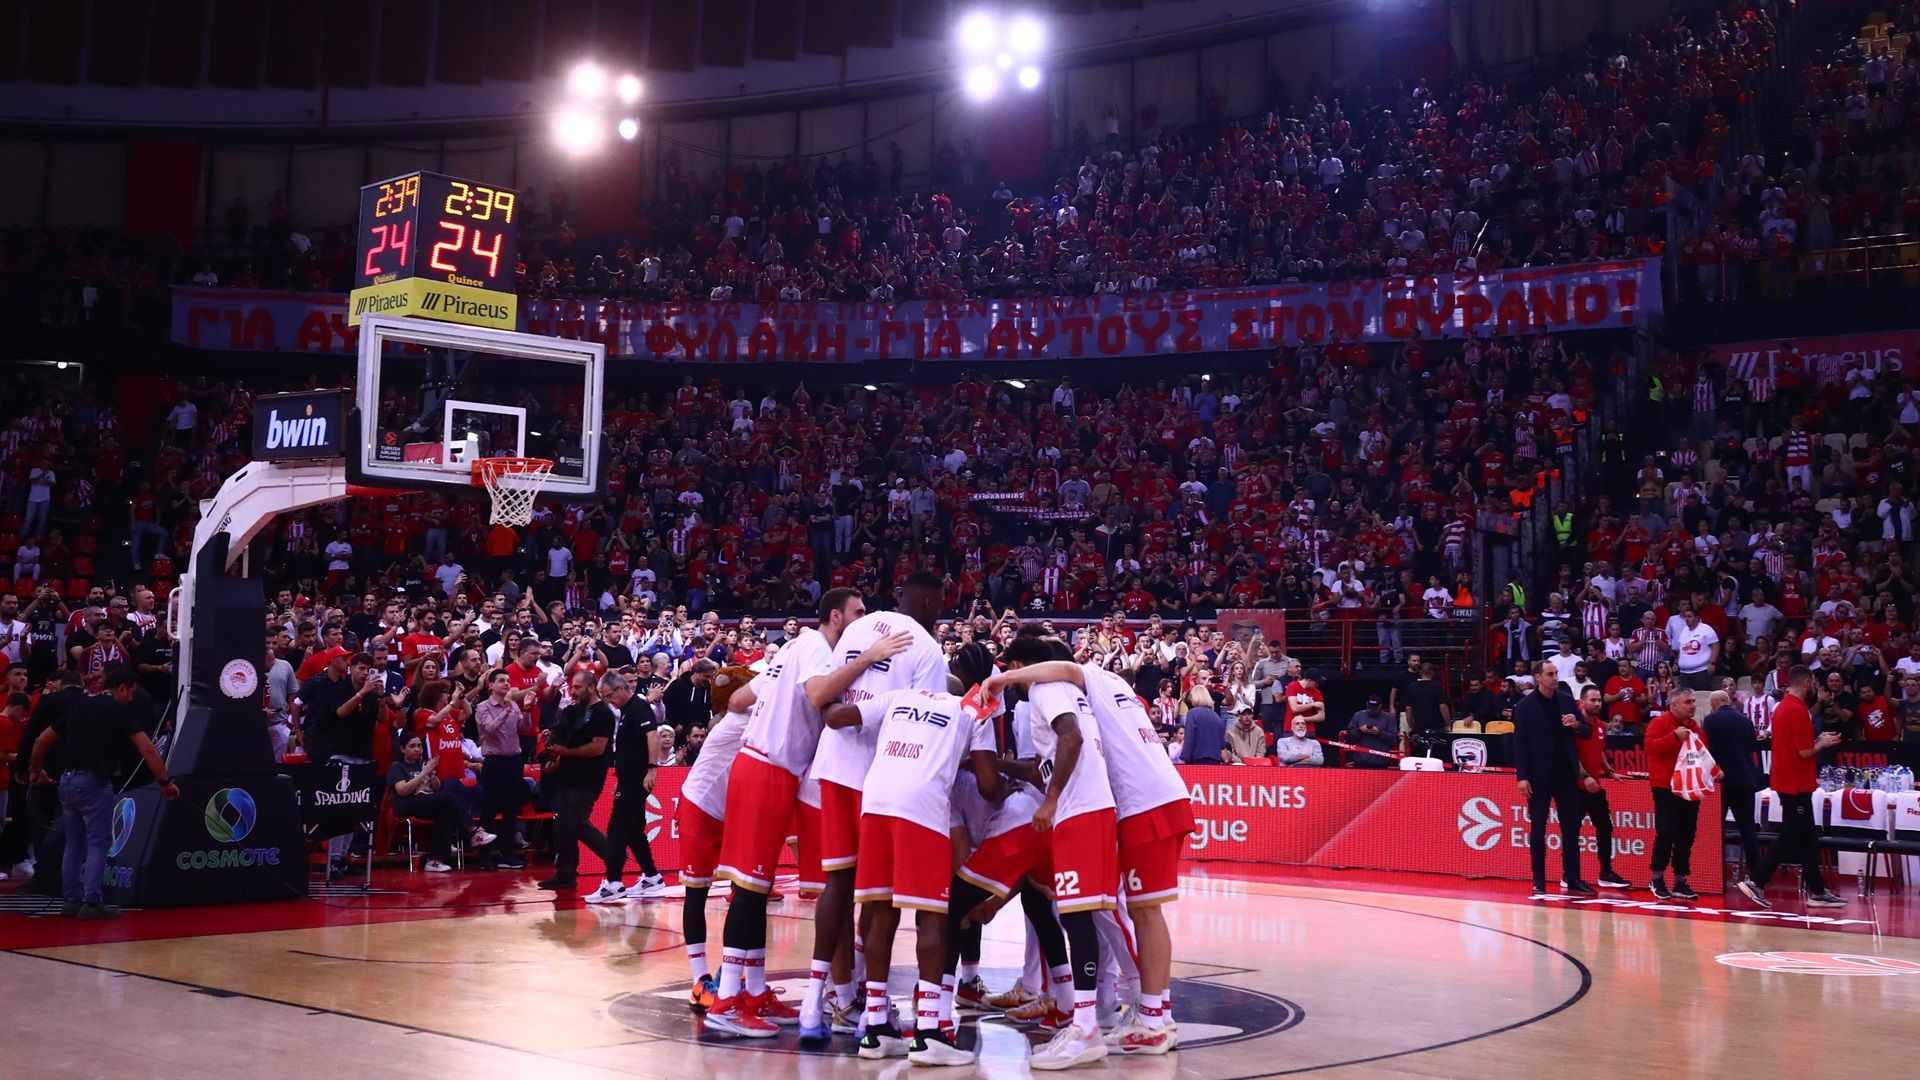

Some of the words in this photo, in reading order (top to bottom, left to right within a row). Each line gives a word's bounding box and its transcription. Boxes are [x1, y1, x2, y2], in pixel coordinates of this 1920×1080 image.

[376, 176, 419, 217] 2:39
[445, 181, 515, 223] 2:39
[365, 220, 411, 276] 24
[430, 221, 503, 277] 24
[447, 273, 484, 288] Quince
[368, 292, 409, 313] Piraeus
[443, 294, 509, 320] Piraeus
[188, 307, 276, 349] ΓΙΑ
[988, 311, 1204, 359] ΑΥΤΟΥΣ
[1227, 302, 1364, 351] ΣΤΟΝ
[1384, 279, 1635, 339] ΟΥΡΑΝΟ!
[266, 404, 326, 449] bwin
[442, 724, 455, 734] 16
[892, 706, 951, 729] FMS
[883, 740, 924, 760] PIRAEUS
[314, 787, 371, 806] SPALDING
[1190, 783, 1306, 809] AIRLINES
[176, 847, 280, 870] COSMOTE
[1054, 870, 1080, 897] 22
[1128, 868, 1143, 892] 6
